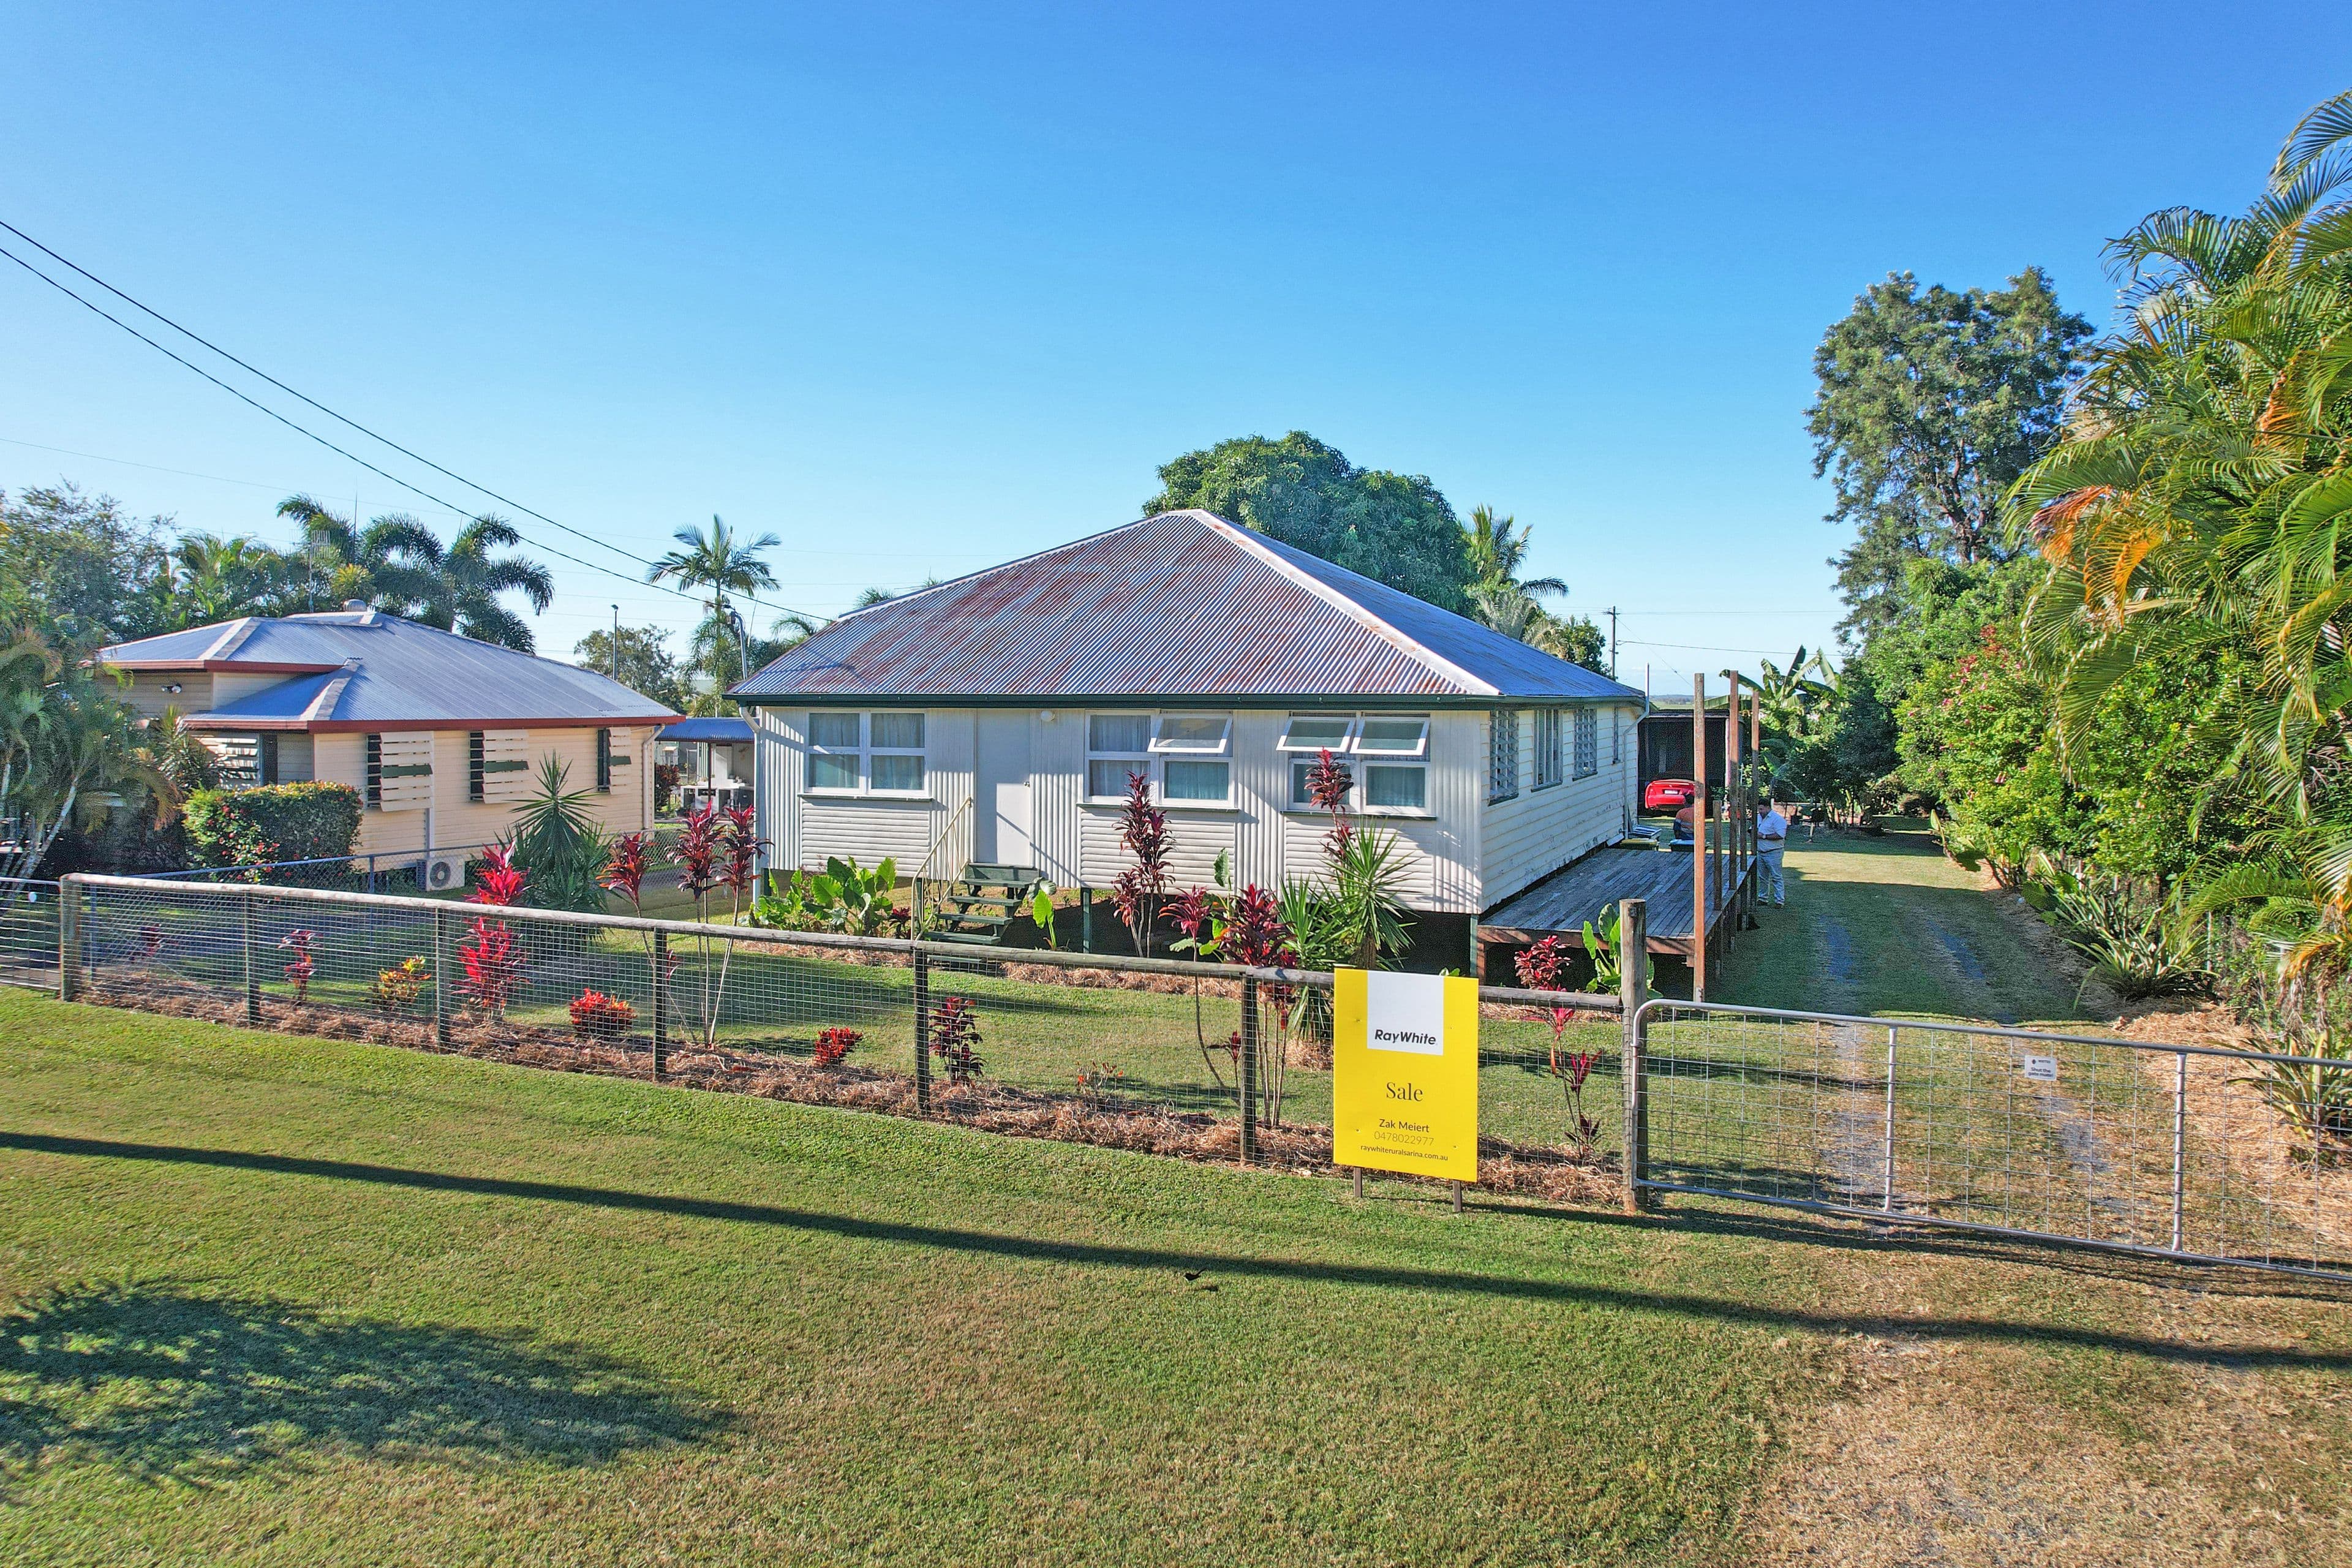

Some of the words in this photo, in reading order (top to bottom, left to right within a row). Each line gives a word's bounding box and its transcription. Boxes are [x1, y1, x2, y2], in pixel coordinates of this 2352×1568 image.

[1374, 1029, 1436, 1045] RayWhite
[1386, 1082, 1423, 1102] Sale
[1379, 1118, 1396, 1129] Zak
[1398, 1121, 1430, 1133] Meiert
[1374, 1131, 1434, 1146] 0478022977
[1360, 1145, 1449, 1161] raywhiteruralsarina.com.au
